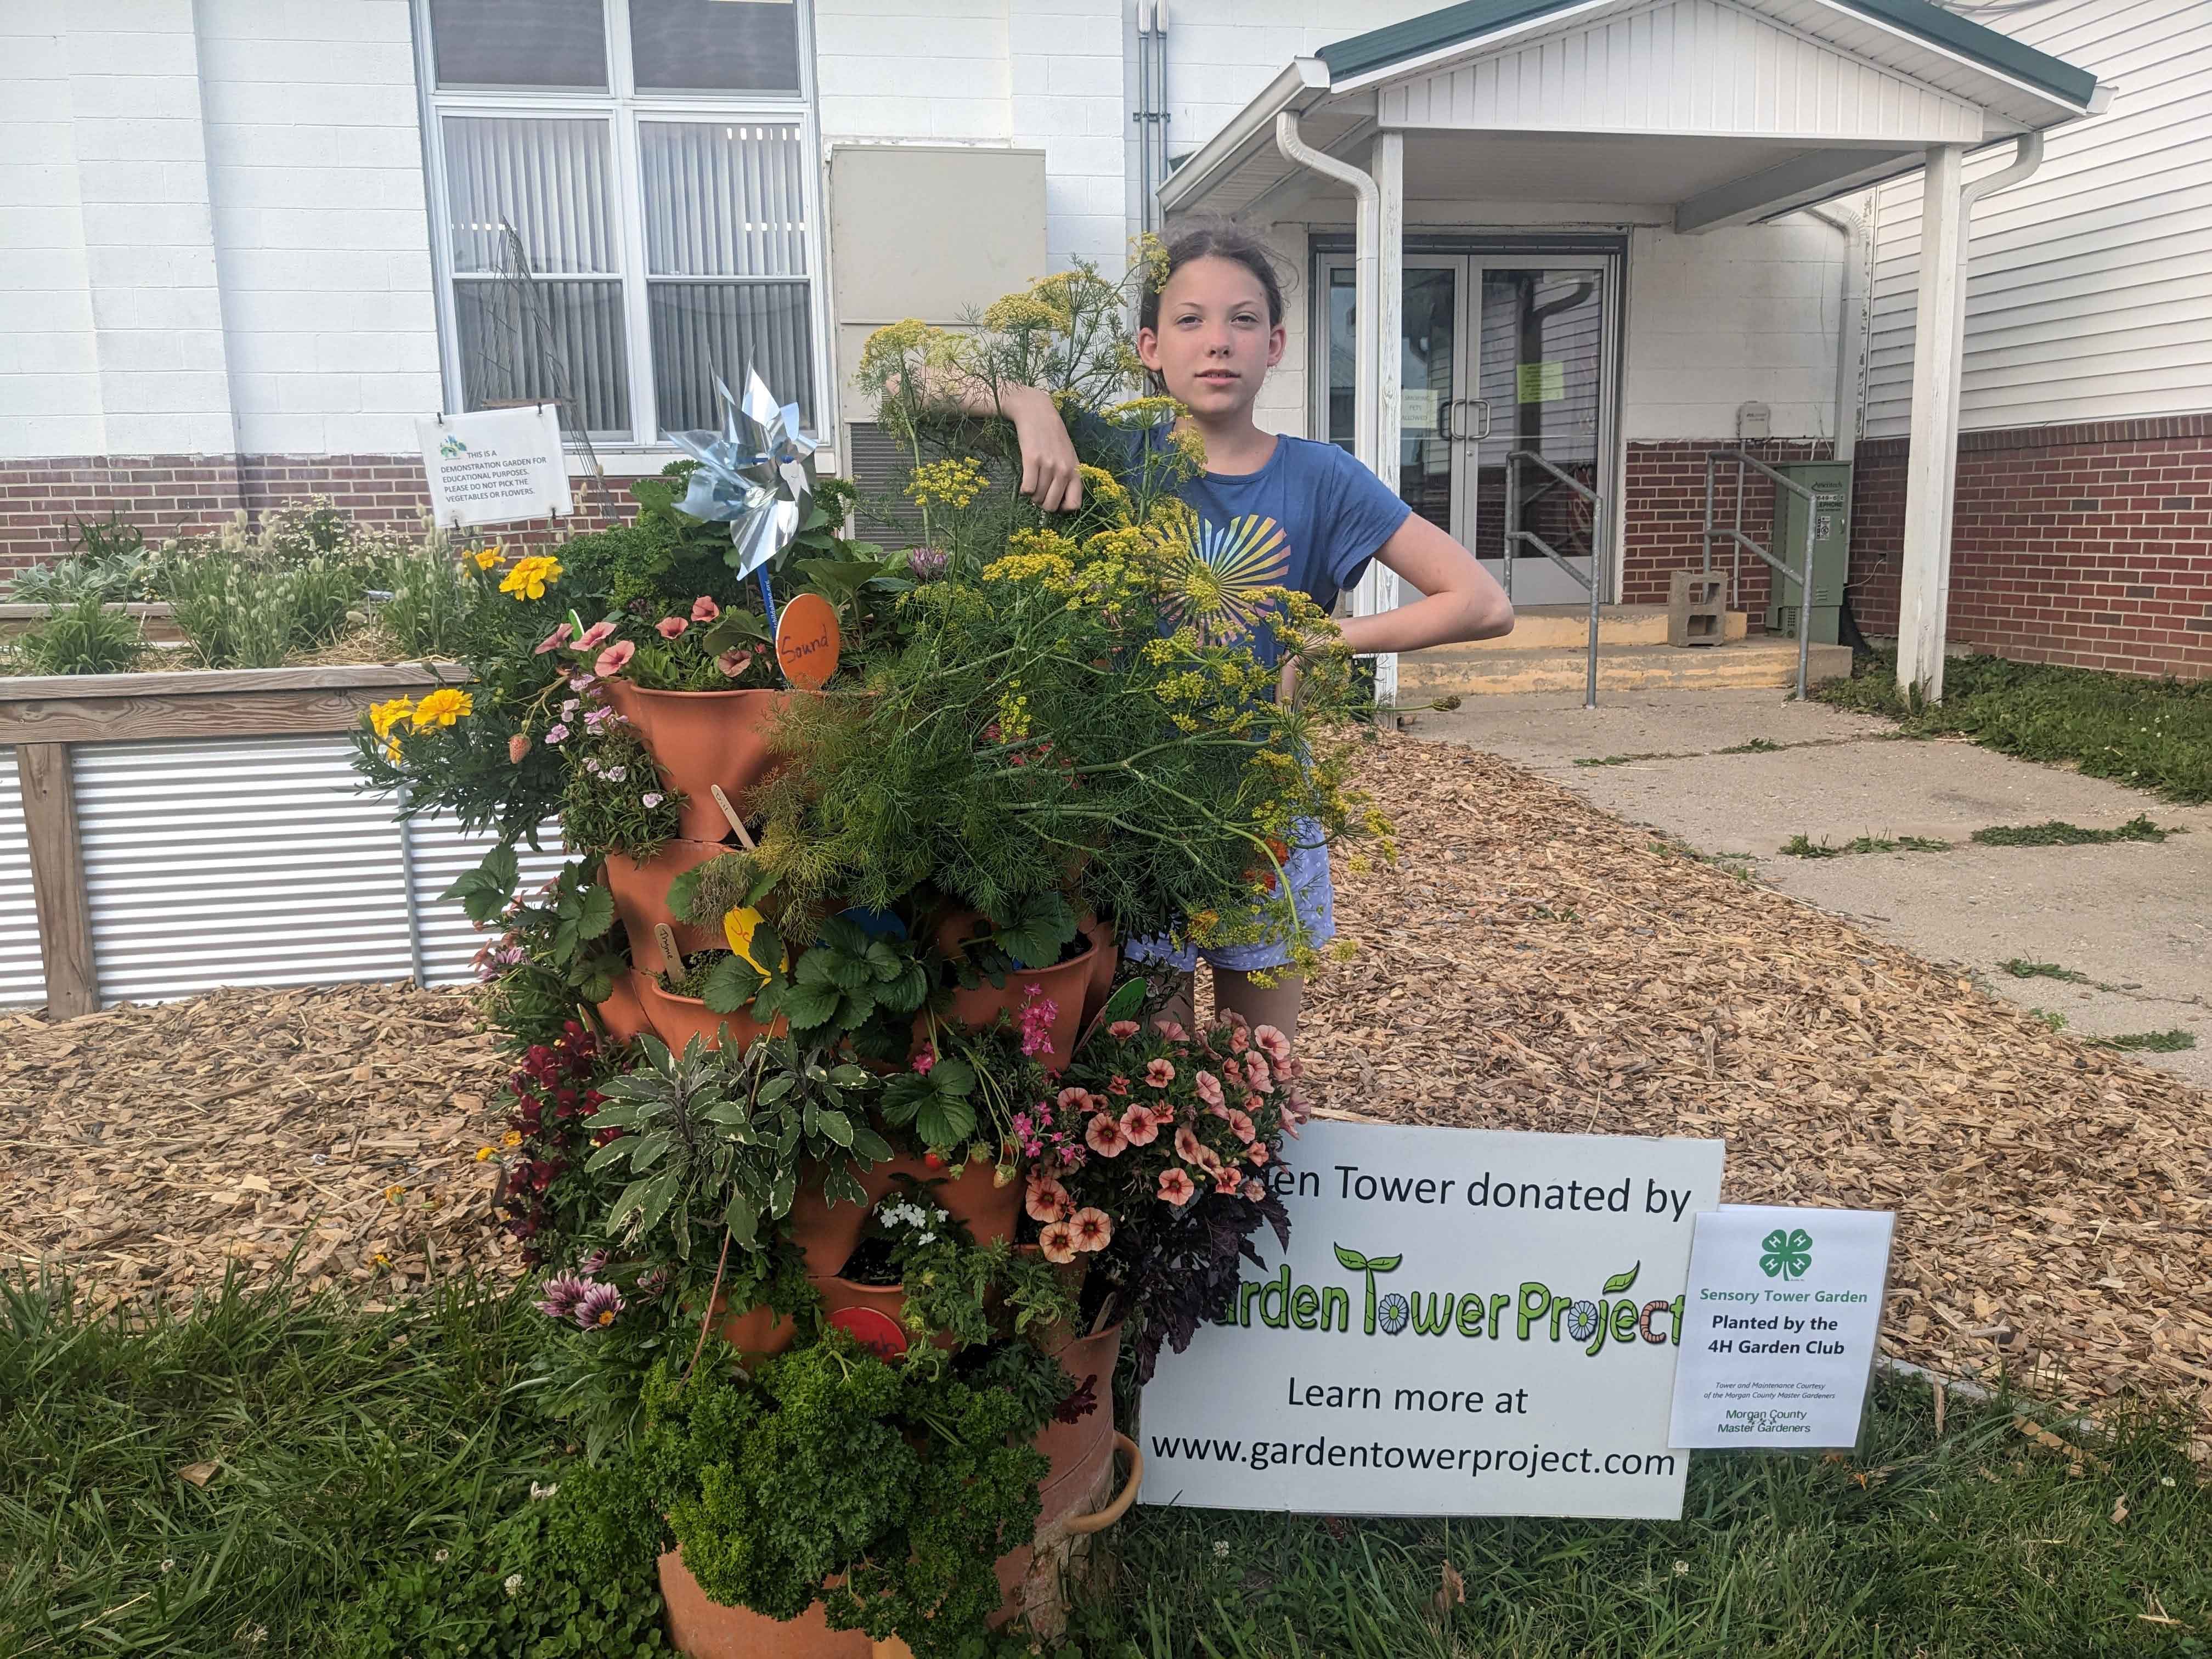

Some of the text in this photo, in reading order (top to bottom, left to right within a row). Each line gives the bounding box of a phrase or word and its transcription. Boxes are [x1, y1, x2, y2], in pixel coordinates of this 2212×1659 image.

[441, 461, 501, 473] DEMONSTRATION
[503, 459, 531, 467] GARDEN
[443, 469, 530, 483] EDUCATIONAL PURPOSES.
[444, 484, 469, 493] PLEASE
[446, 492, 489, 503] VEGETABLES
[501, 488, 535, 498] FLOWERS.
[781, 623, 829, 663] Sound
[660, 927, 673, 960] Thyme
[1334, 1165, 1455, 1204] Tower
[1467, 1172, 1630, 1212] donated
[1645, 1178, 1692, 1222] by
[1700, 1288, 1867, 1304] Sensory Tower Garden
[1712, 1315, 1838, 1334] Planted by the
[1708, 1340, 1845, 1355] 4H Garden Club
[1288, 1377, 1529, 1414] Learn more at
[1725, 1392, 1750, 1400] Morgan
[1726, 1409, 1807, 1421] Morgan County
[1718, 1423, 1811, 1433] Master Gardeners
[1152, 1434, 1675, 1479] www.gardentowerproject.com
